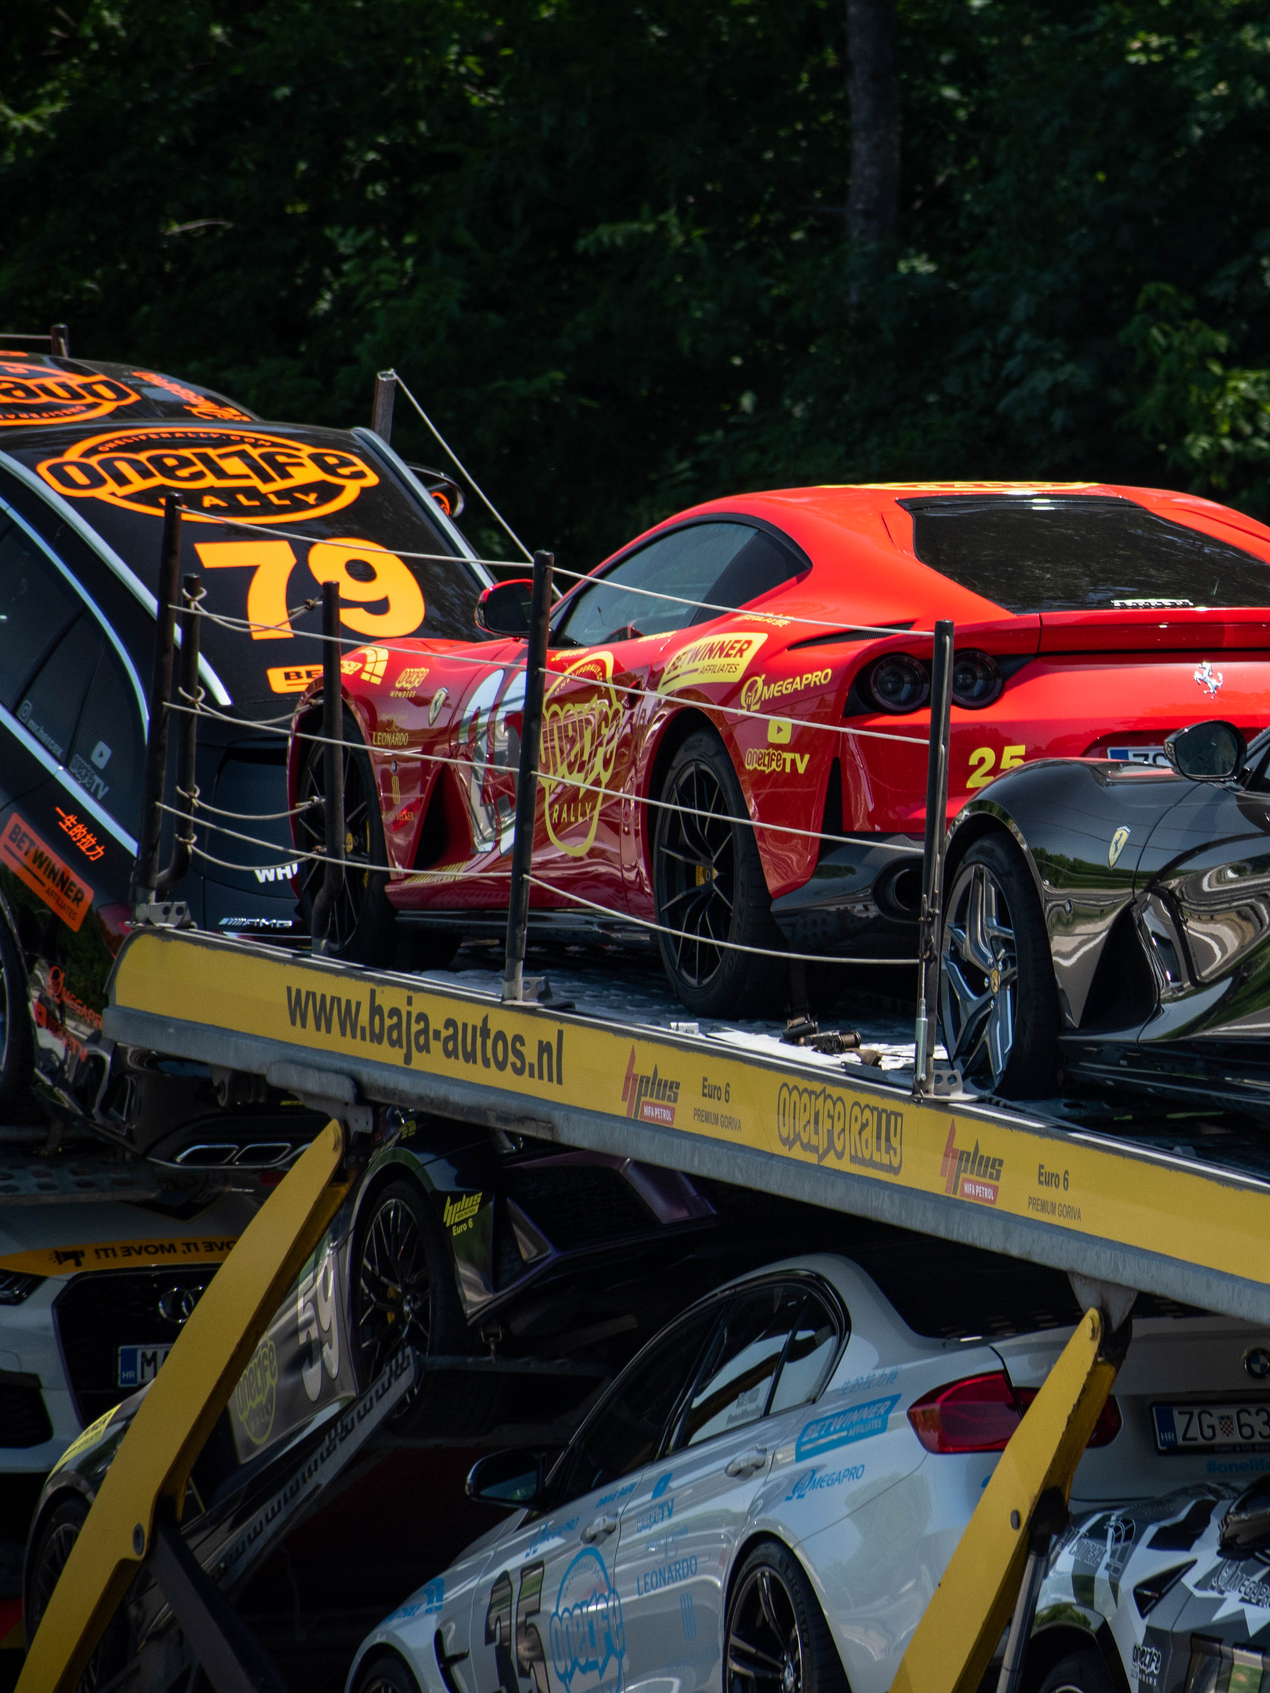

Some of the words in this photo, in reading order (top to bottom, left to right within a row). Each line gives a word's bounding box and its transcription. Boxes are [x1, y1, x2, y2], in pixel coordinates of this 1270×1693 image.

[195, 537, 425, 640] 79
[668, 639, 754, 676] BETWINNER
[698, 663, 741, 676] AFFILIATES
[372, 731, 409, 747] LEONARDO
[965, 744, 1027, 789] 25
[551, 802, 593, 824] RALLY
[54, 806, 106, 862] 一生的拉力
[8, 823, 86, 899] BETWINNER
[44, 884, 79, 921] AFFILIATES
[285, 984, 564, 1086] www.baja-autos.nl
[701, 1076, 722, 1101] Euro
[724, 1082, 731, 1104] 6
[643, 1105, 655, 1117] HIFA
[654, 1107, 673, 1122] PETROL
[693, 1107, 719, 1128] PREMIUM
[720, 1113, 743, 1133] GORIVA
[963, 1182, 976, 1195] HIFA
[975, 1184, 995, 1201] PETROL
[1037, 1163, 1060, 1189] Euro
[1062, 1169, 1070, 1192] 6
[1027, 1196, 1056, 1216] PREMIUM
[1057, 1202, 1082, 1222] GORIVA
[452, 1222, 468, 1237] Euro
[468, 1217, 474, 1229] 6
[121, 1370, 136, 1380] HR
[801, 1400, 892, 1443] BETWINNER
[848, 1420, 883, 1438] AFFILIATES
[1177, 1410, 1217, 1442] ZG
[1161, 1431, 1175, 1442] HR
[636, 1555, 698, 1597] LEONARDO
